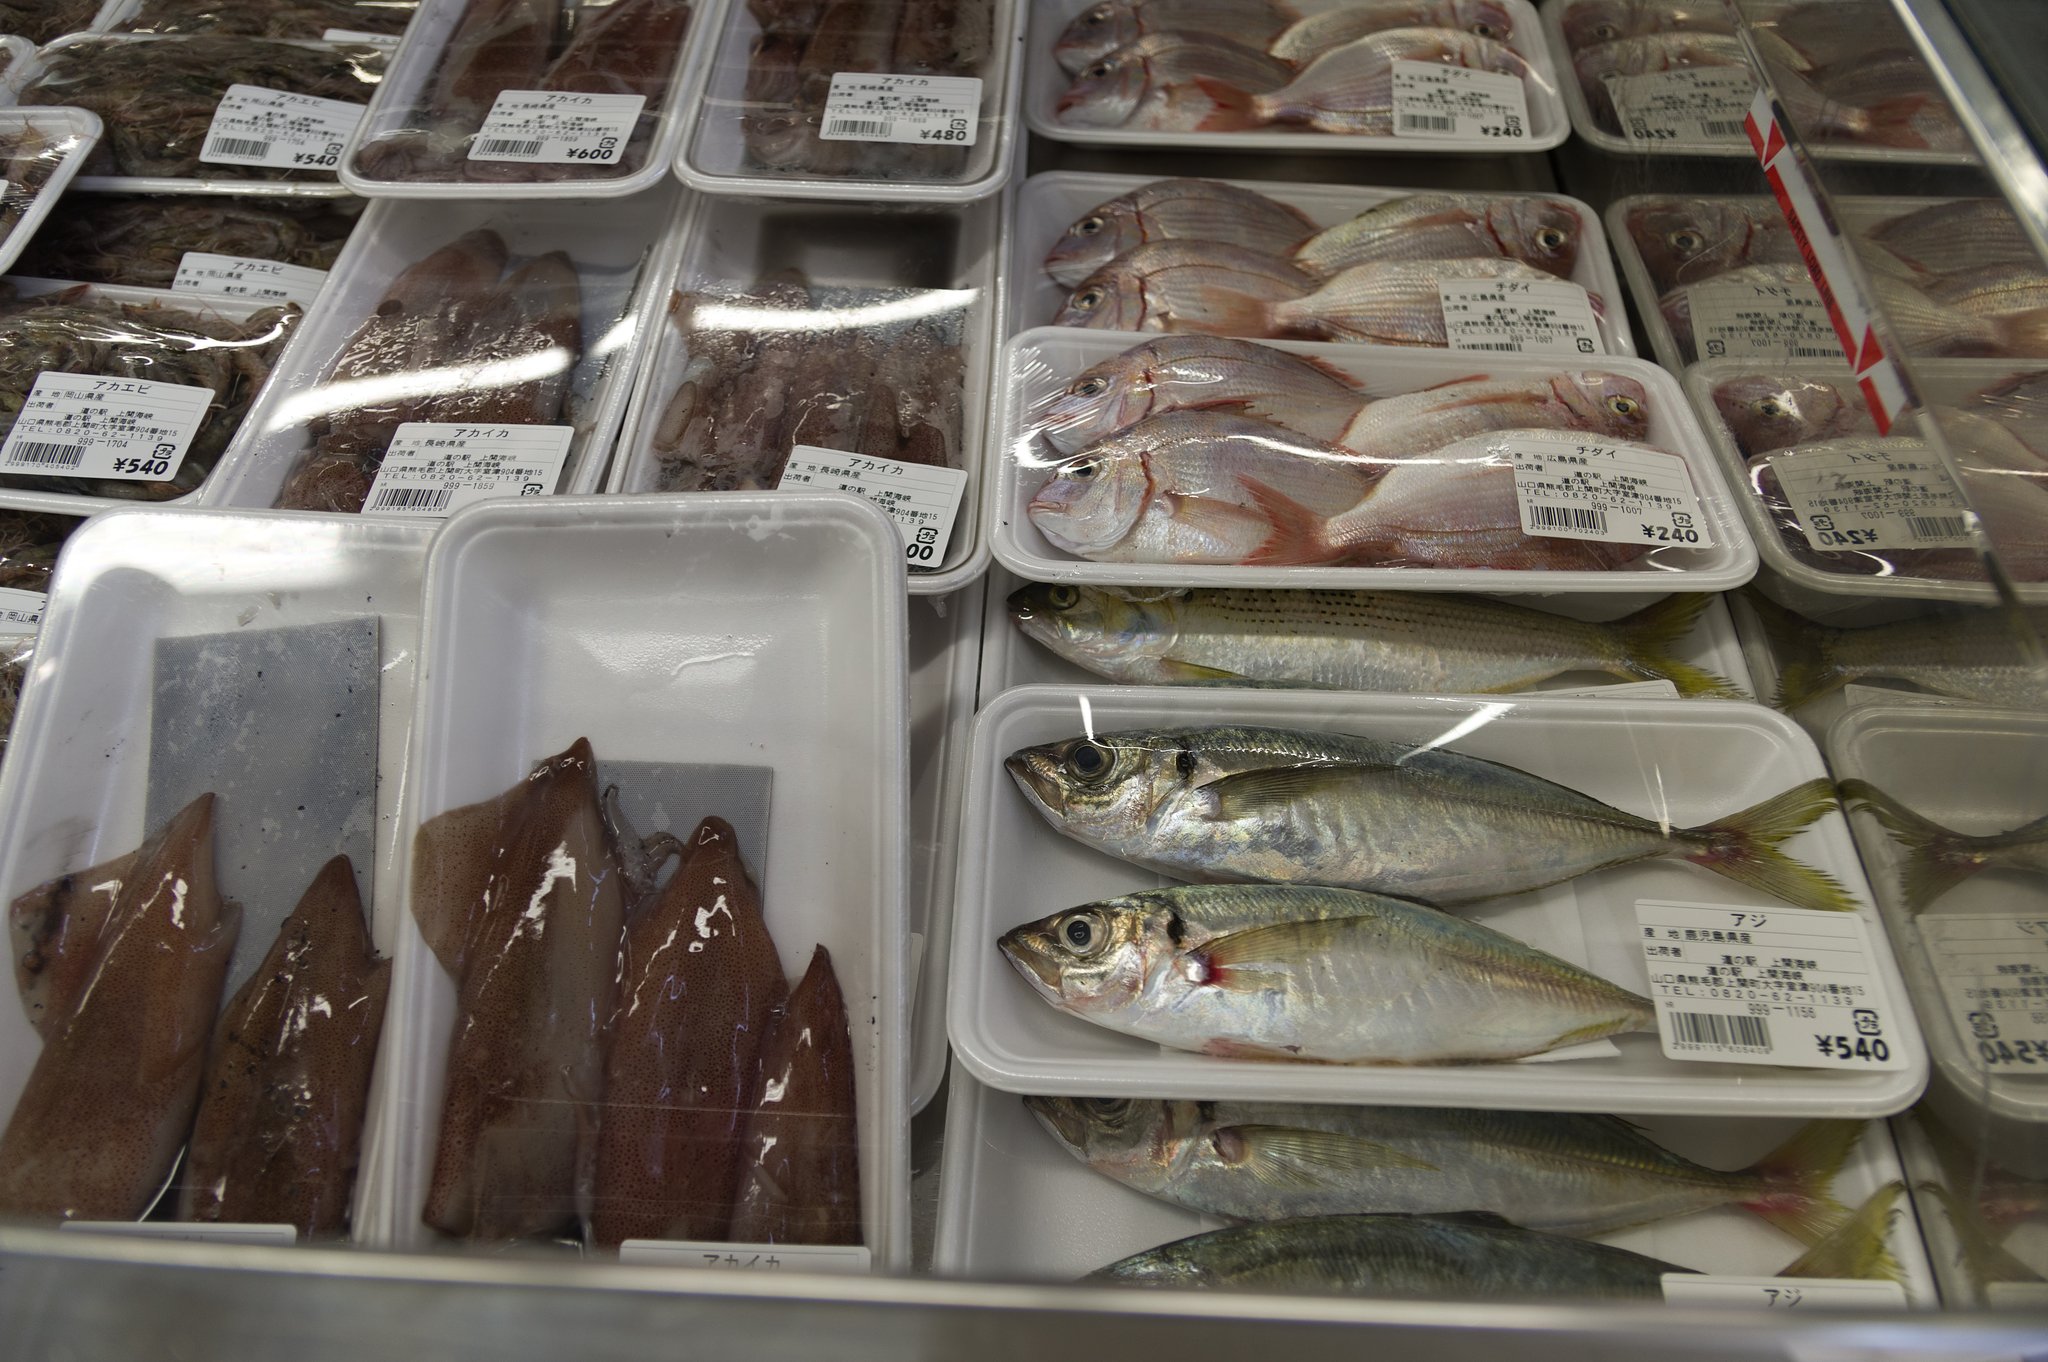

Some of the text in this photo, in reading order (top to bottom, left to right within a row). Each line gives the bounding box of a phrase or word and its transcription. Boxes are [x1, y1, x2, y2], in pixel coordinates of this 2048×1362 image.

[882, 78, 928, 86] アカイカ
[920, 130, 966, 141] ¥480
[1480, 125, 1523, 137] ¥240
[293, 153, 337, 166] ¥540
[566, 148, 613, 160] ¥600
[232, 262, 284, 275] アカエビ
[93, 381, 152, 395] アカエビ
[64, 391, 104, 401] 岡山県産
[27, 401, 54, 409] 出荷者
[81, 407, 108, 416] 道の駅
[64, 414, 92, 422] 道の駅
[454, 428, 509, 438] アカイカ
[424, 440, 466, 448] 長崎県産
[1576, 446, 1616, 459] チダイ
[1547, 455, 1588, 465] 広島県産
[113, 458, 169, 475] ¥540
[849, 458, 904, 476] アカイカ
[1516, 464, 1543, 472] 出荷者
[784, 473, 810, 483] 出荷者
[820, 466, 861, 480] 長崎県産
[1574, 471, 1602, 480] 道の駅
[1561, 477, 1589, 486] 道の駅
[838, 483, 866, 495] 道の駅
[1641, 524, 1699, 543] ¥240
[6, 611, 41, 624] 岡山県
[1731, 912, 1767, 927] アジ
[1685, 929, 1752, 944] 鹿児島県産
[1647, 947, 1682, 958] 出荷者
[1721, 955, 1757, 966] 道の駅
[1707, 966, 1742, 977] 道の駅
[1814, 1035, 1890, 1061] ¥540
[1763, 1287, 1803, 1308] アジ
